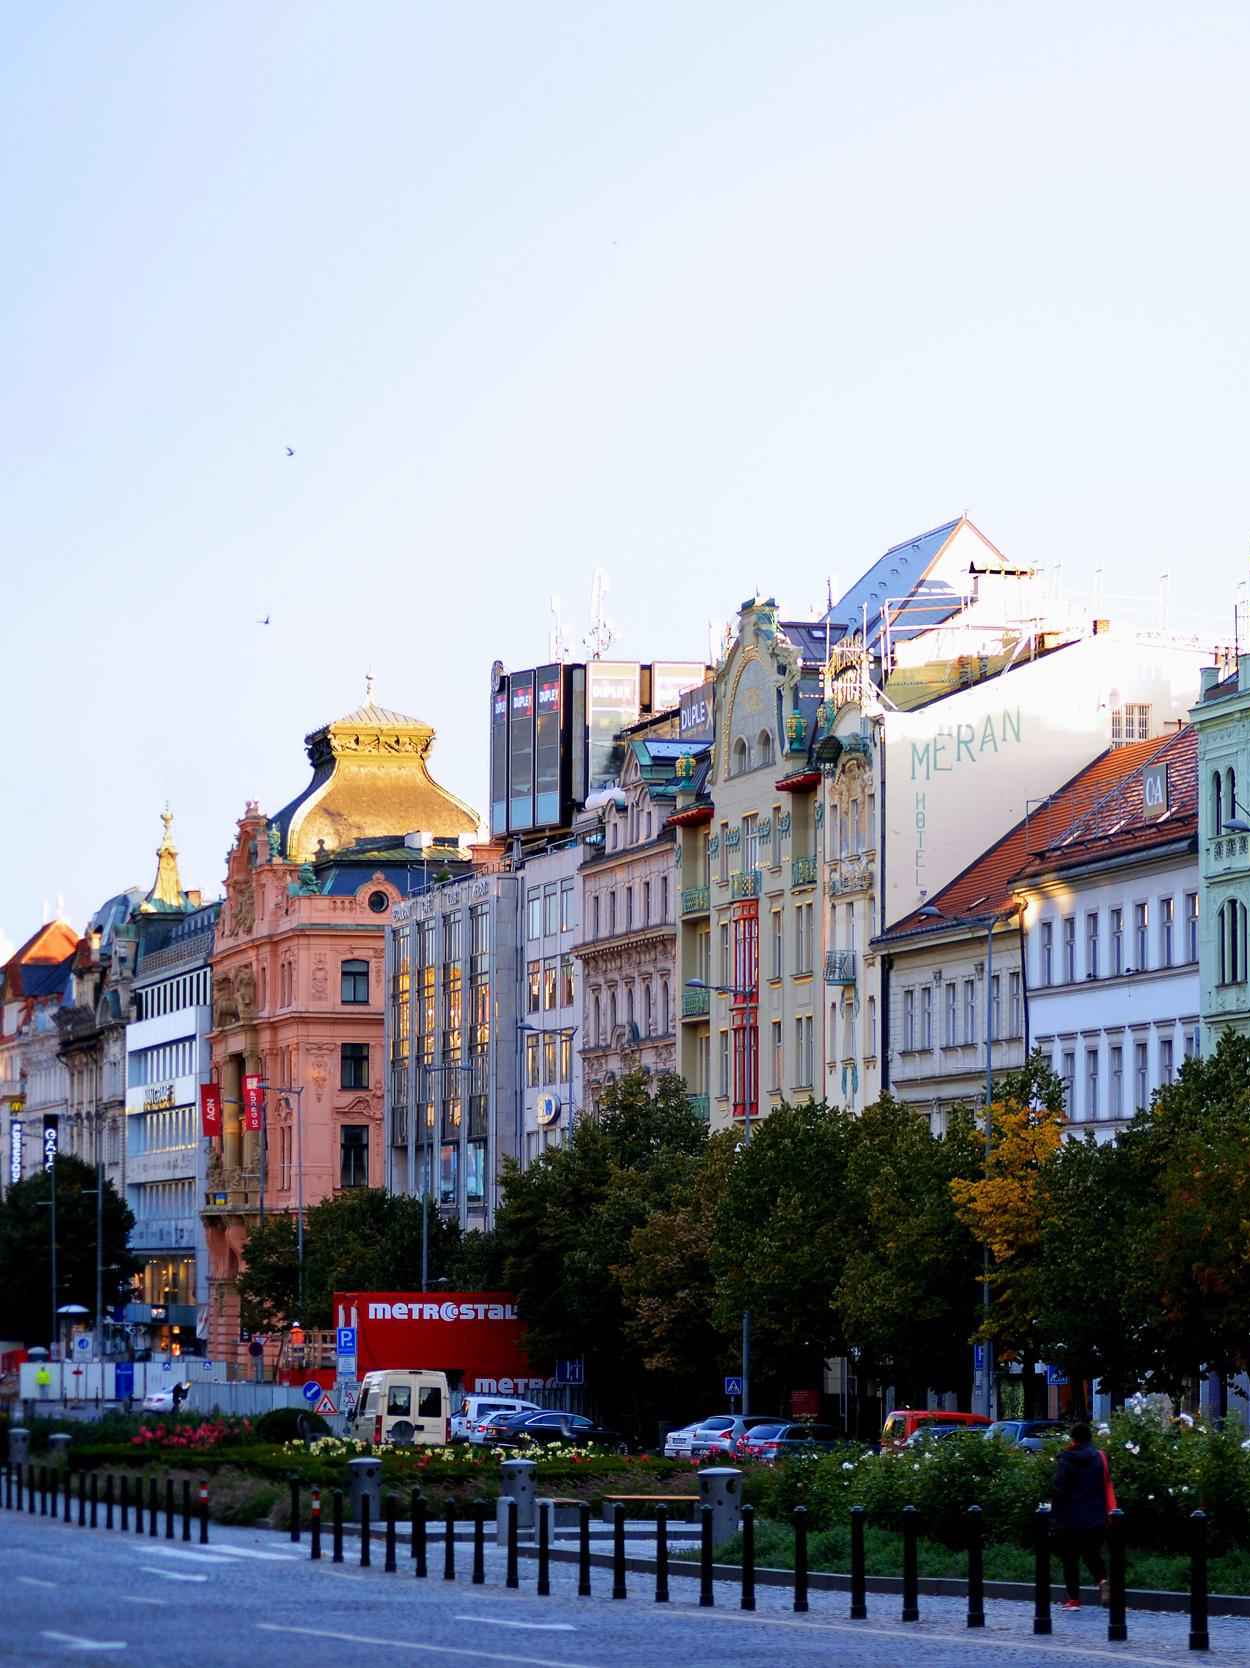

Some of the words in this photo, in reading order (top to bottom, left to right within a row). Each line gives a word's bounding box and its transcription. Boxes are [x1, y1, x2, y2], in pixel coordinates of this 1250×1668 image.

[539, 688, 560, 704] DUPLEX
[592, 684, 631, 701] DUPLEX
[681, 699, 714, 730] DUPLEX
[910, 705, 1021, 781] MERAN
[1146, 775, 1163, 807] C&A
[915, 792, 926, 887] HOTEL
[206, 1098, 215, 1121] AON
